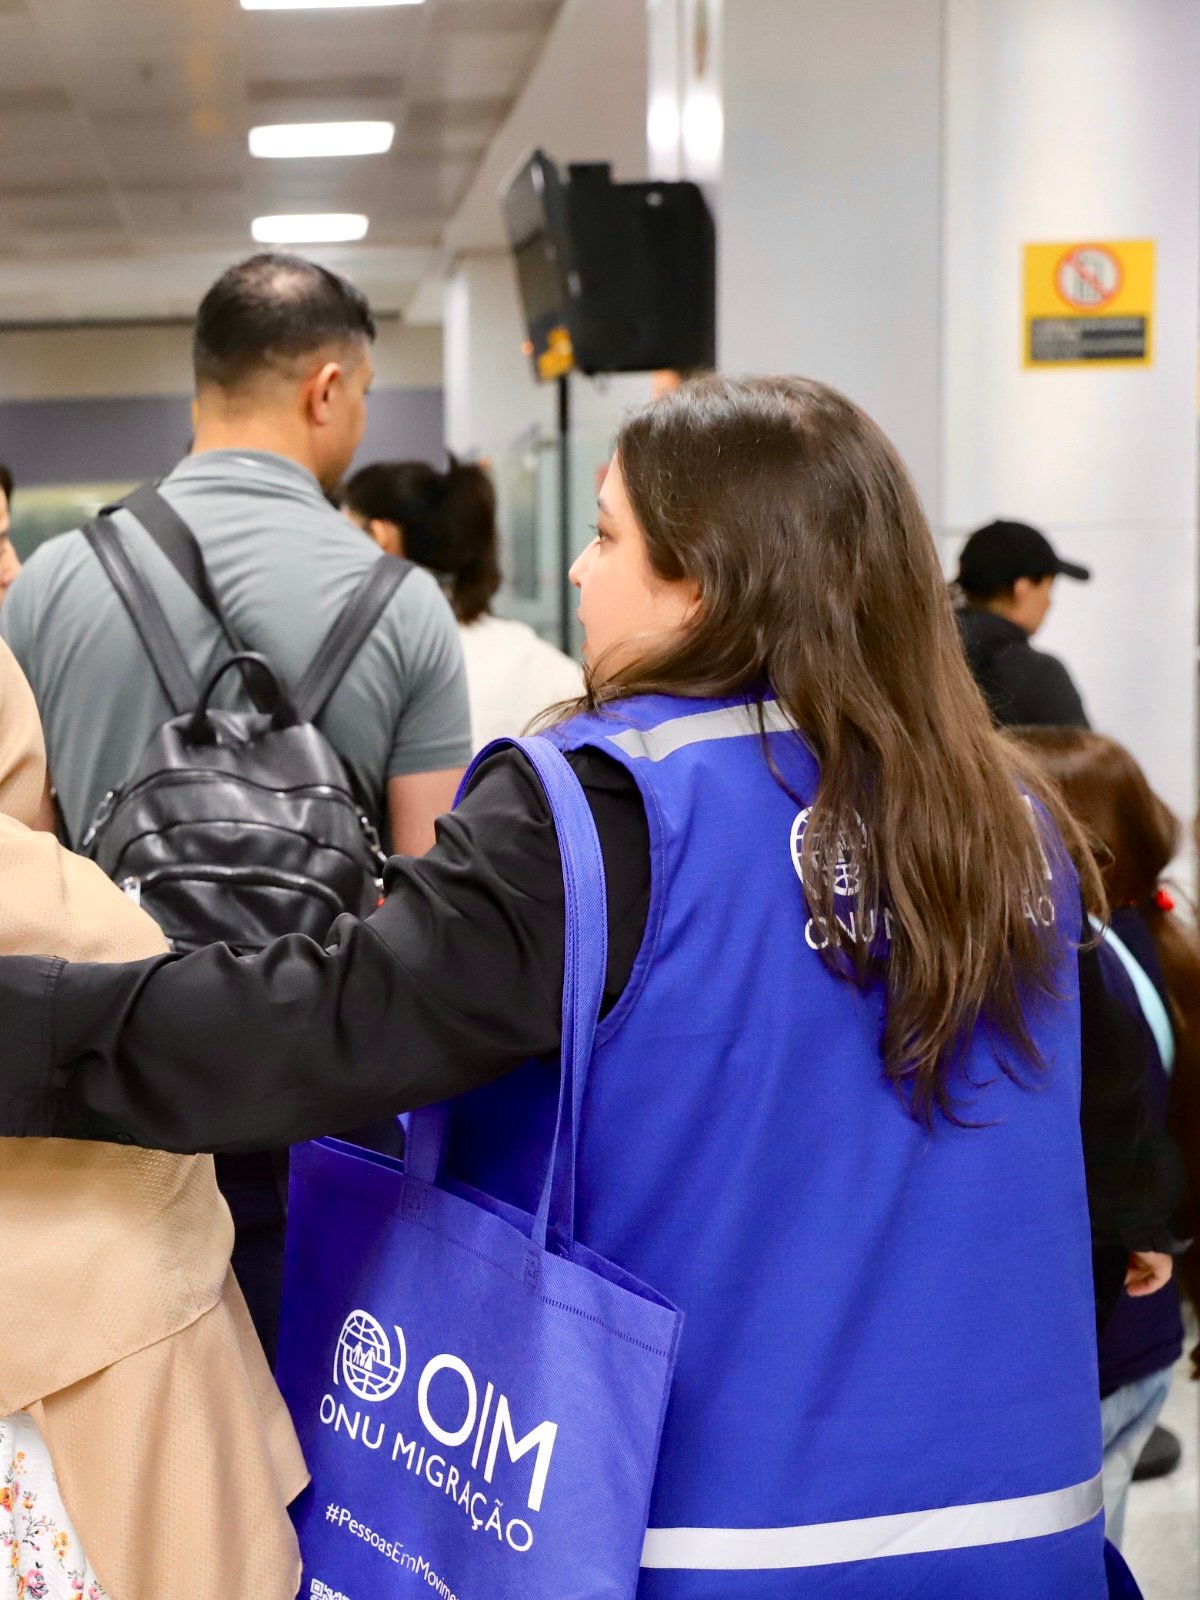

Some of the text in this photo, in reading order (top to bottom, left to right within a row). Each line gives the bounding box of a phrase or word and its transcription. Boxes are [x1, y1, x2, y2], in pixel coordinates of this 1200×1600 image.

[319, 1393, 533, 1552] ONU MIGRAÇÃO
[418, 1353, 558, 1512] OIM
